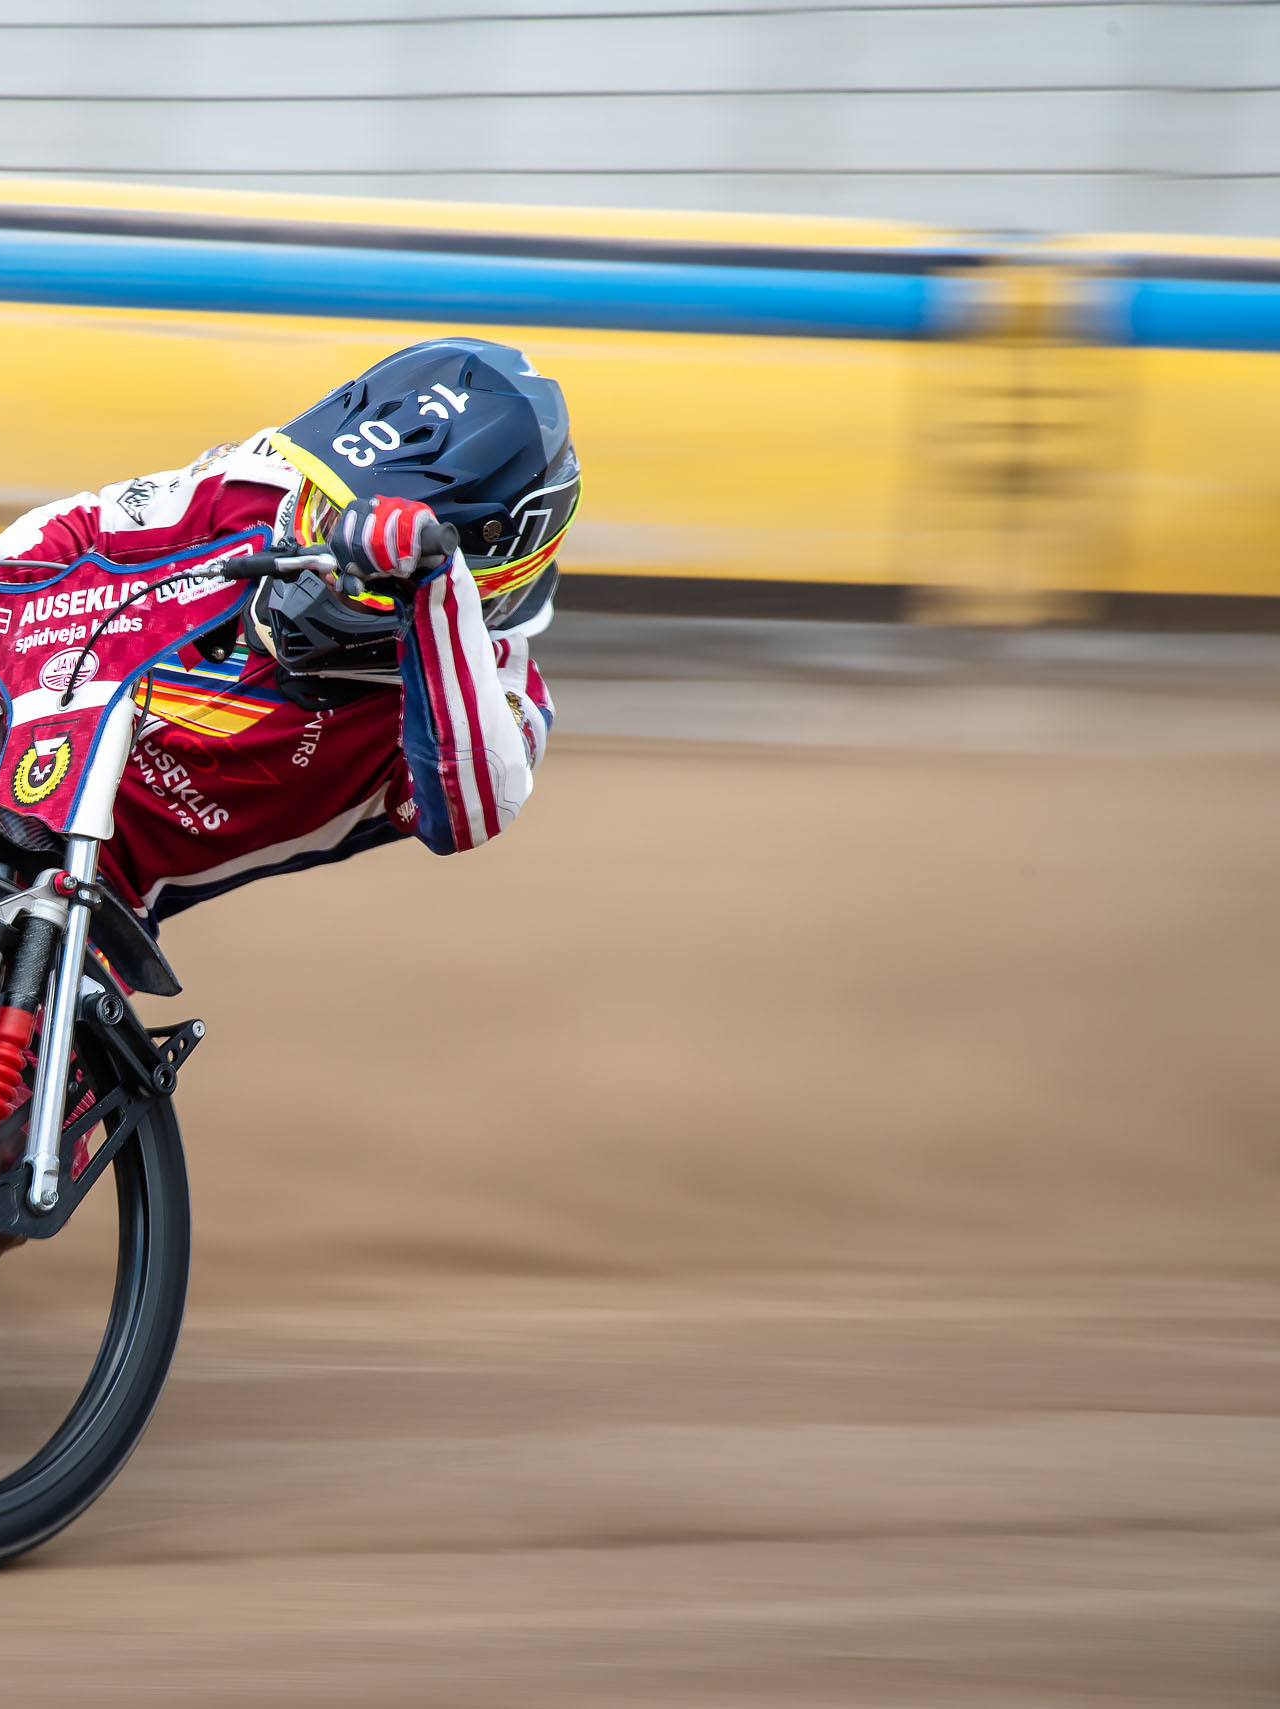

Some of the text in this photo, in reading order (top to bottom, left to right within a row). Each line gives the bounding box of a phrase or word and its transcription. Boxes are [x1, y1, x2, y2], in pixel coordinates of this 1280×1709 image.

[332, 420, 401, 468] 03
[19, 580, 149, 627] AUSEKLIS
[15, 623, 87, 654] spidveja
